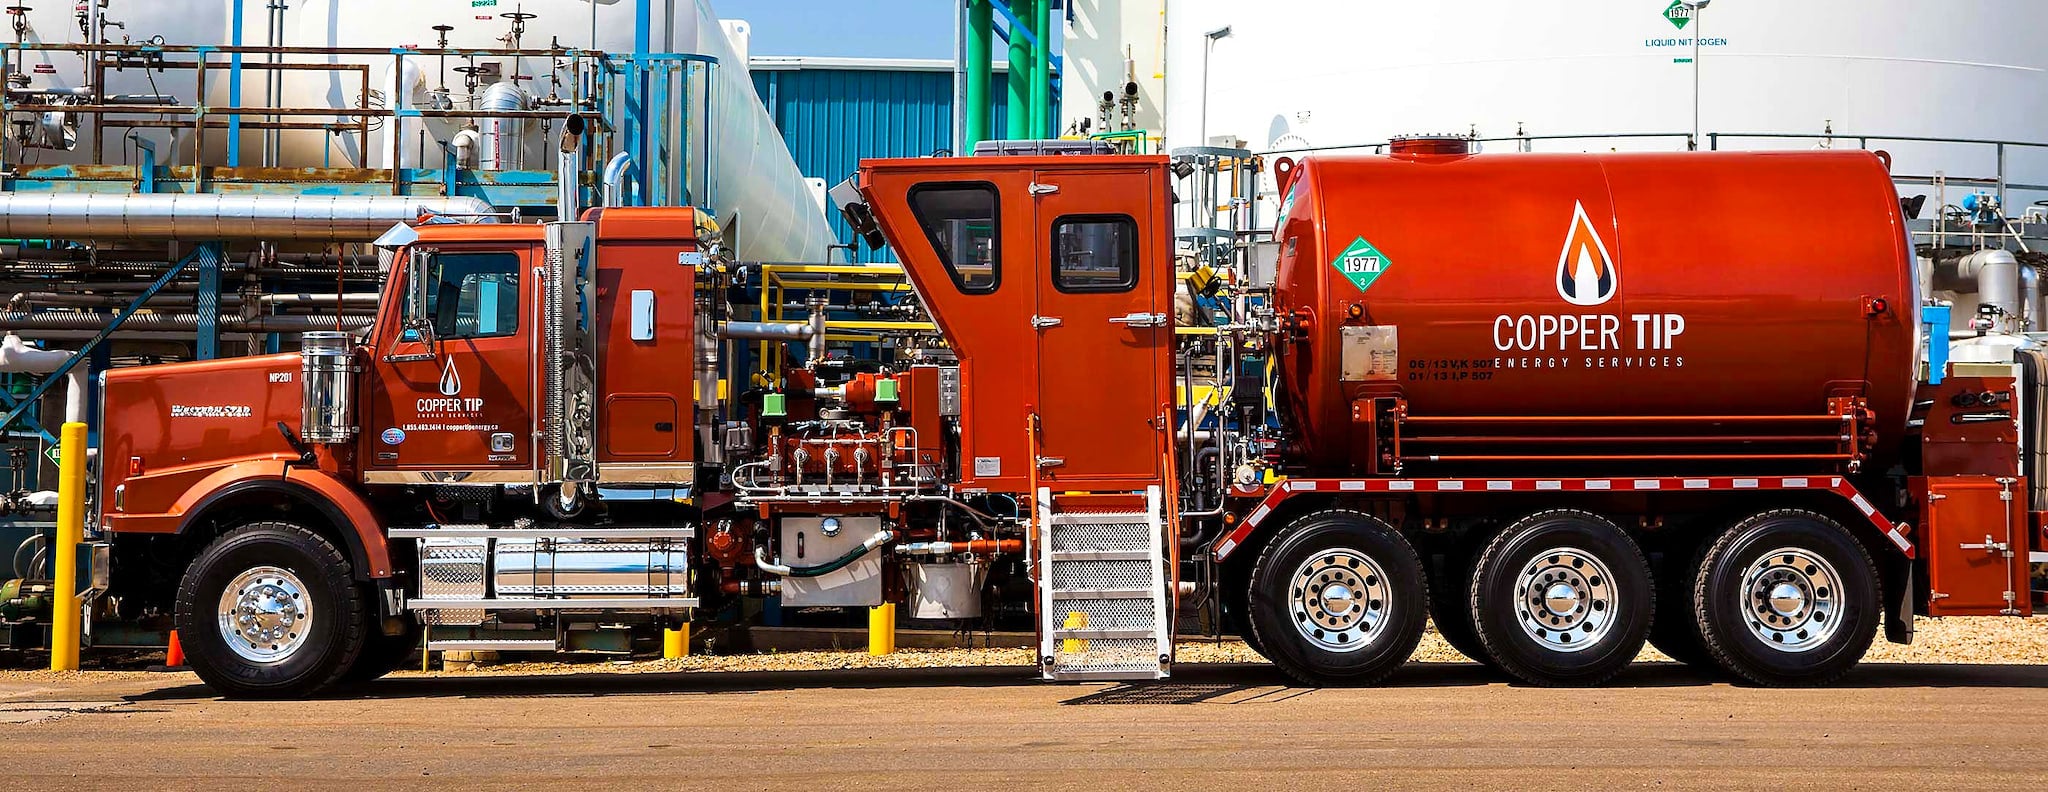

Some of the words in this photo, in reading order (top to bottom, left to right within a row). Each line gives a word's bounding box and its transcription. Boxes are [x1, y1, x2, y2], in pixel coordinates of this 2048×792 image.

[1670, 8, 1689, 18] 1977
[1645, 39, 1676, 47] LIQUID
[1345, 257, 1377, 272] 1977
[1360, 278, 1366, 286] 2
[1493, 314, 1620, 351] COPPER
[1631, 313, 1685, 350] TIP
[1472, 359, 1494, 369] 507
[1494, 357, 1570, 368] ENERGY
[1585, 356, 1685, 368] SERVICES
[269, 372, 293, 382] NP201
[1472, 371, 1493, 381] 507
[416, 398, 461, 412] COPPER
[464, 398, 484, 412] TIP
[446, 423, 499, 432] coppertipenergy.ca
